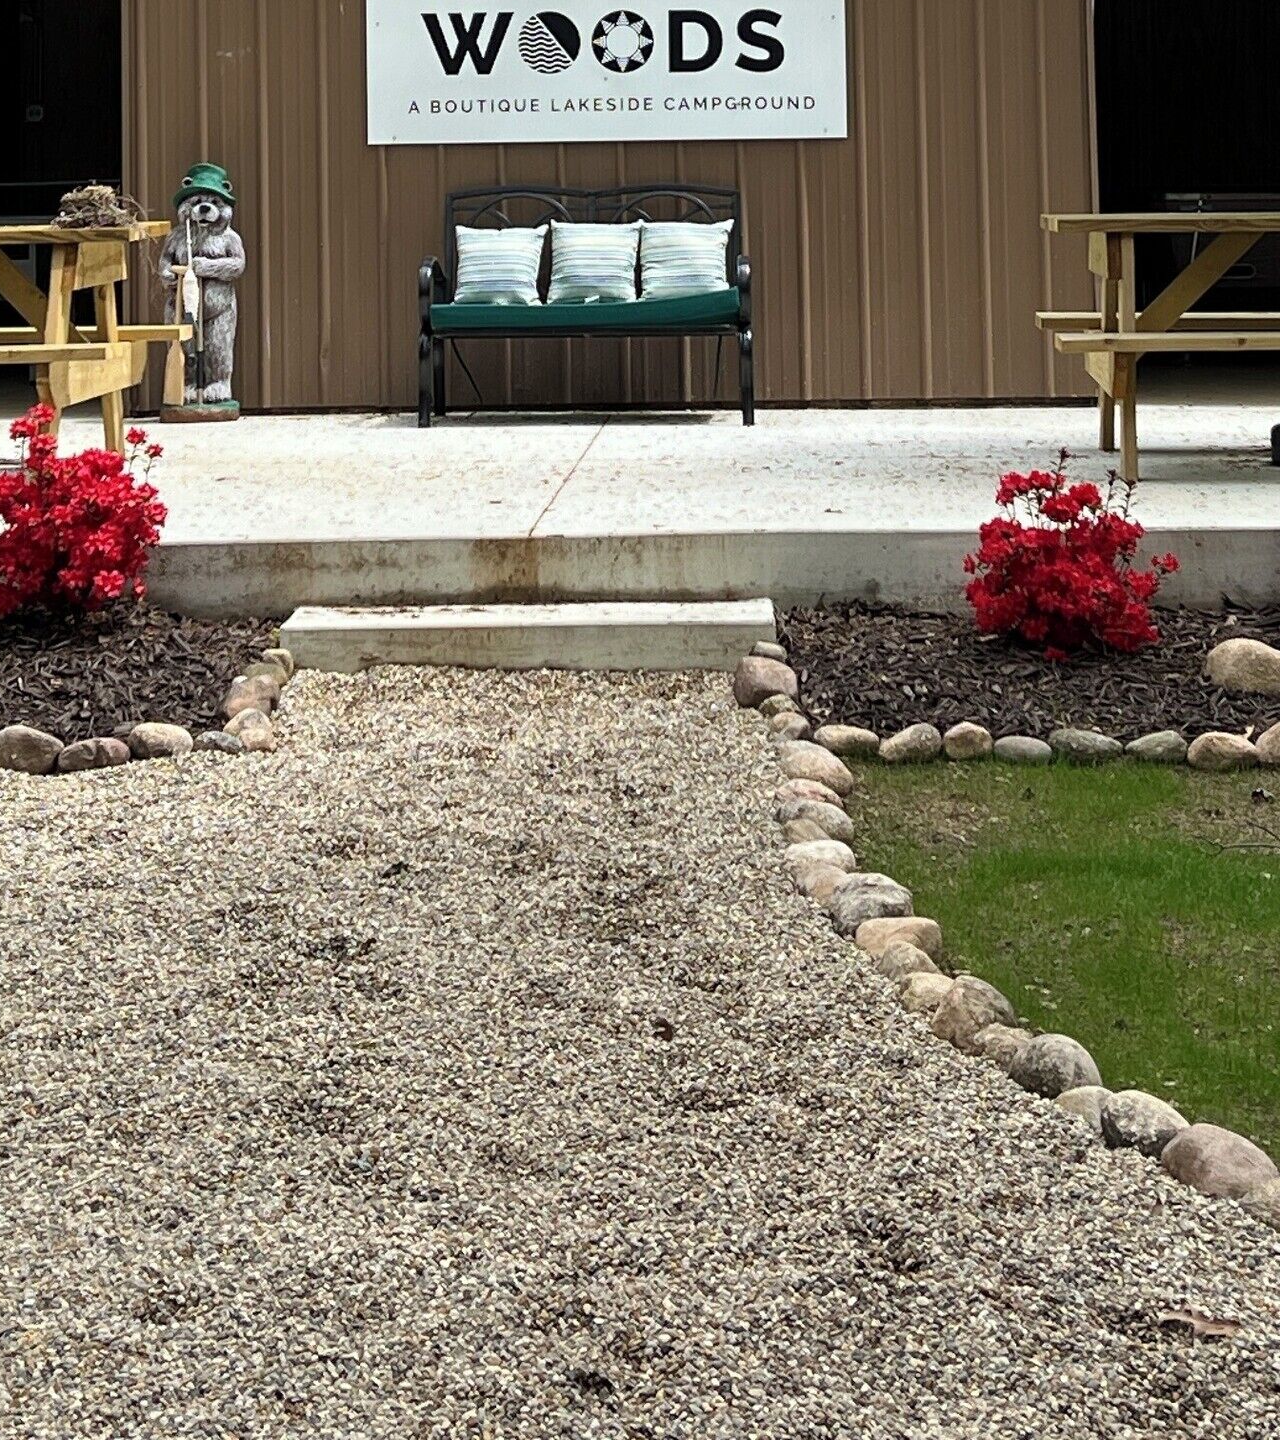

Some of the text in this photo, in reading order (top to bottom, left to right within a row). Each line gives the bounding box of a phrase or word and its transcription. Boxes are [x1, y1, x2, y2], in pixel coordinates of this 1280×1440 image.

[420, 8, 786, 76] WOODS
[408, 95, 817, 115] A BOUTIQUE LAKESIDE CAMPGROUND
